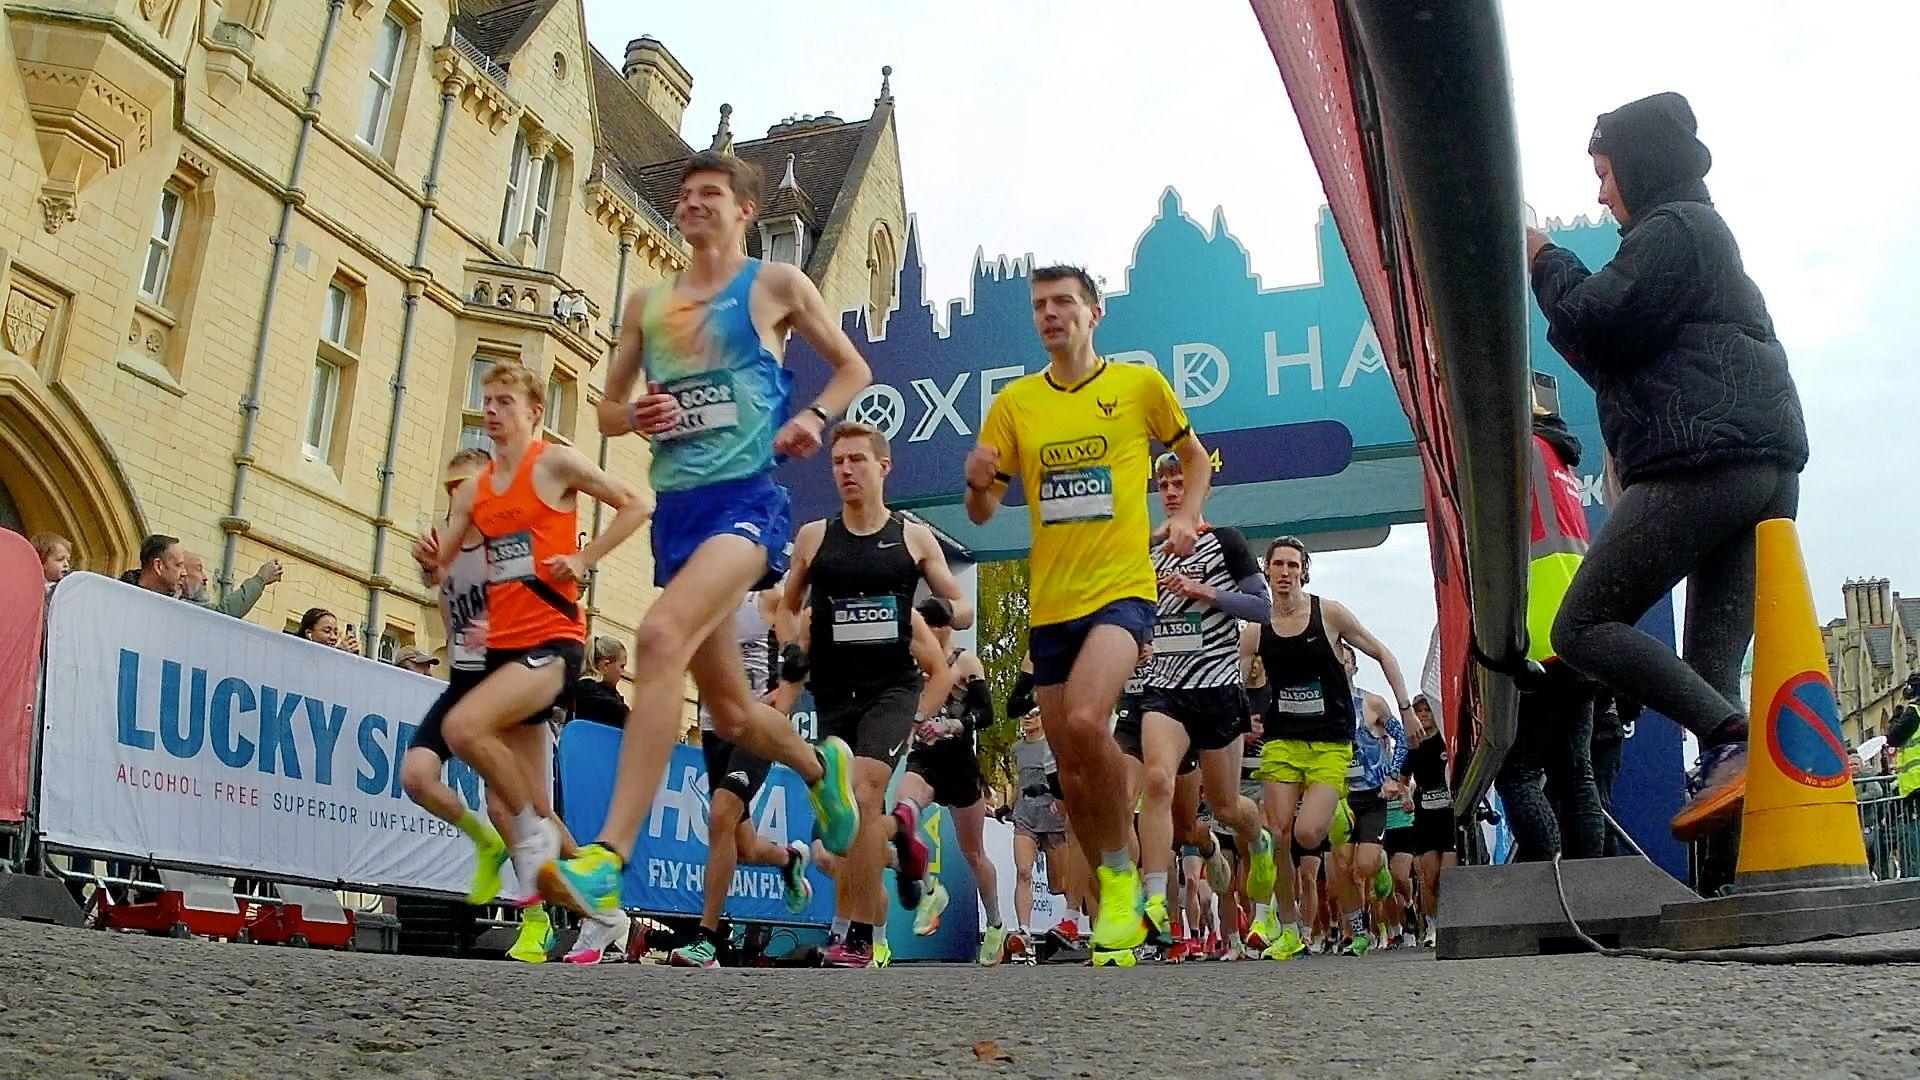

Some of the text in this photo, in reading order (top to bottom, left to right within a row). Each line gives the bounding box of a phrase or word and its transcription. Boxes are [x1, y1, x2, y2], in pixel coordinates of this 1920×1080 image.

[846, 342, 1230, 442] OXFD
[1048, 442, 1098, 463] WANG
[1055, 479, 1106, 497] A1001
[848, 607, 895, 621] A5001
[1162, 622, 1198, 636] A3501
[117, 648, 348, 786] LUCKY
[116, 763, 202, 797] ALCOHOL
[214, 782, 259, 806] FREE
[273, 792, 358, 825] SUPERIOR
[649, 858, 683, 890] FLY
[685, 862, 758, 899] HAN
